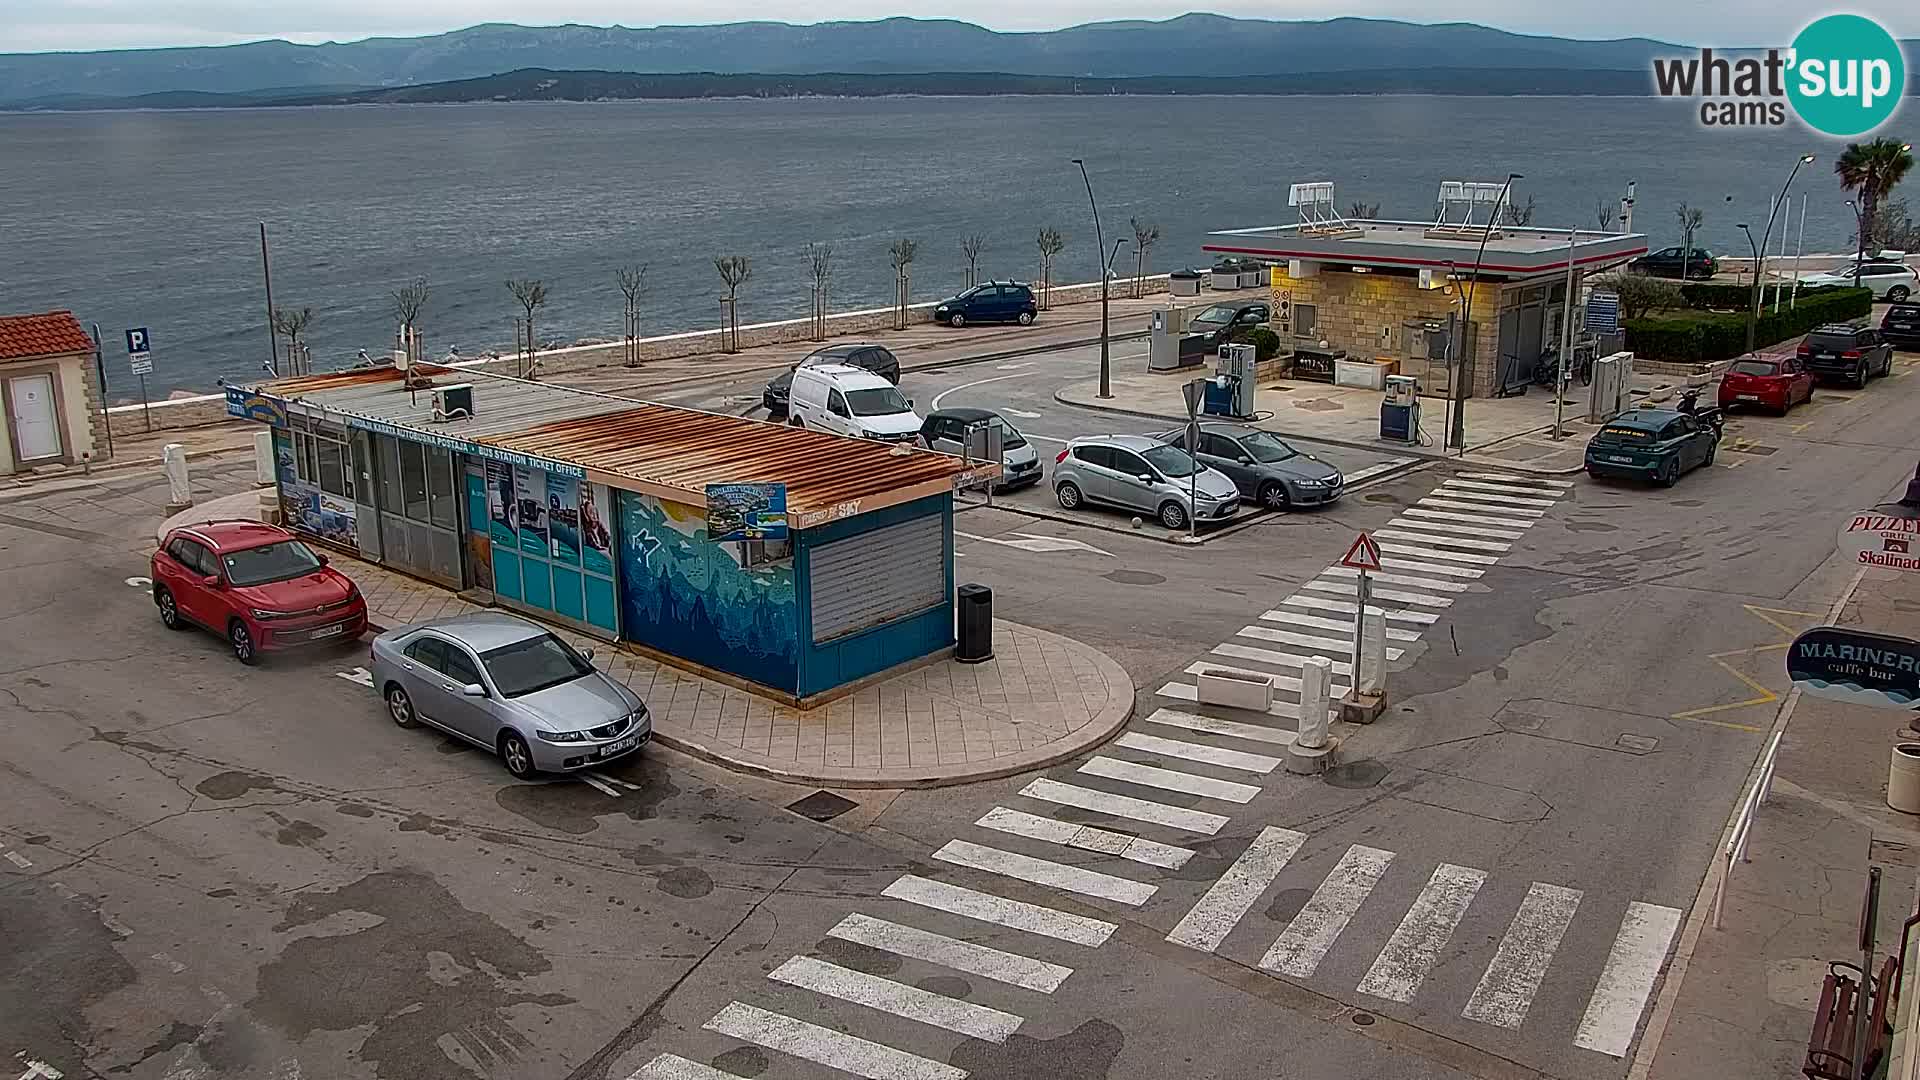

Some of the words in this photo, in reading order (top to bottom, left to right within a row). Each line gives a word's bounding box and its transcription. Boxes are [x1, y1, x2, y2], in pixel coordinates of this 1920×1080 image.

[131, 331, 144, 350] P
[397, 428, 437, 445] AUTOBUSNA
[437, 437, 469, 453] POSTAJA
[478, 447, 494, 458] BUS
[494, 450, 527, 465] STATION
[529, 457, 555, 471] TICKET
[556, 462, 583, 478] OFFICE
[838, 499, 862, 517] SKY
[1880, 531, 1916, 542] GRILL
[1828, 663, 1865, 676] caffe
[1868, 666, 1896, 681] bar
